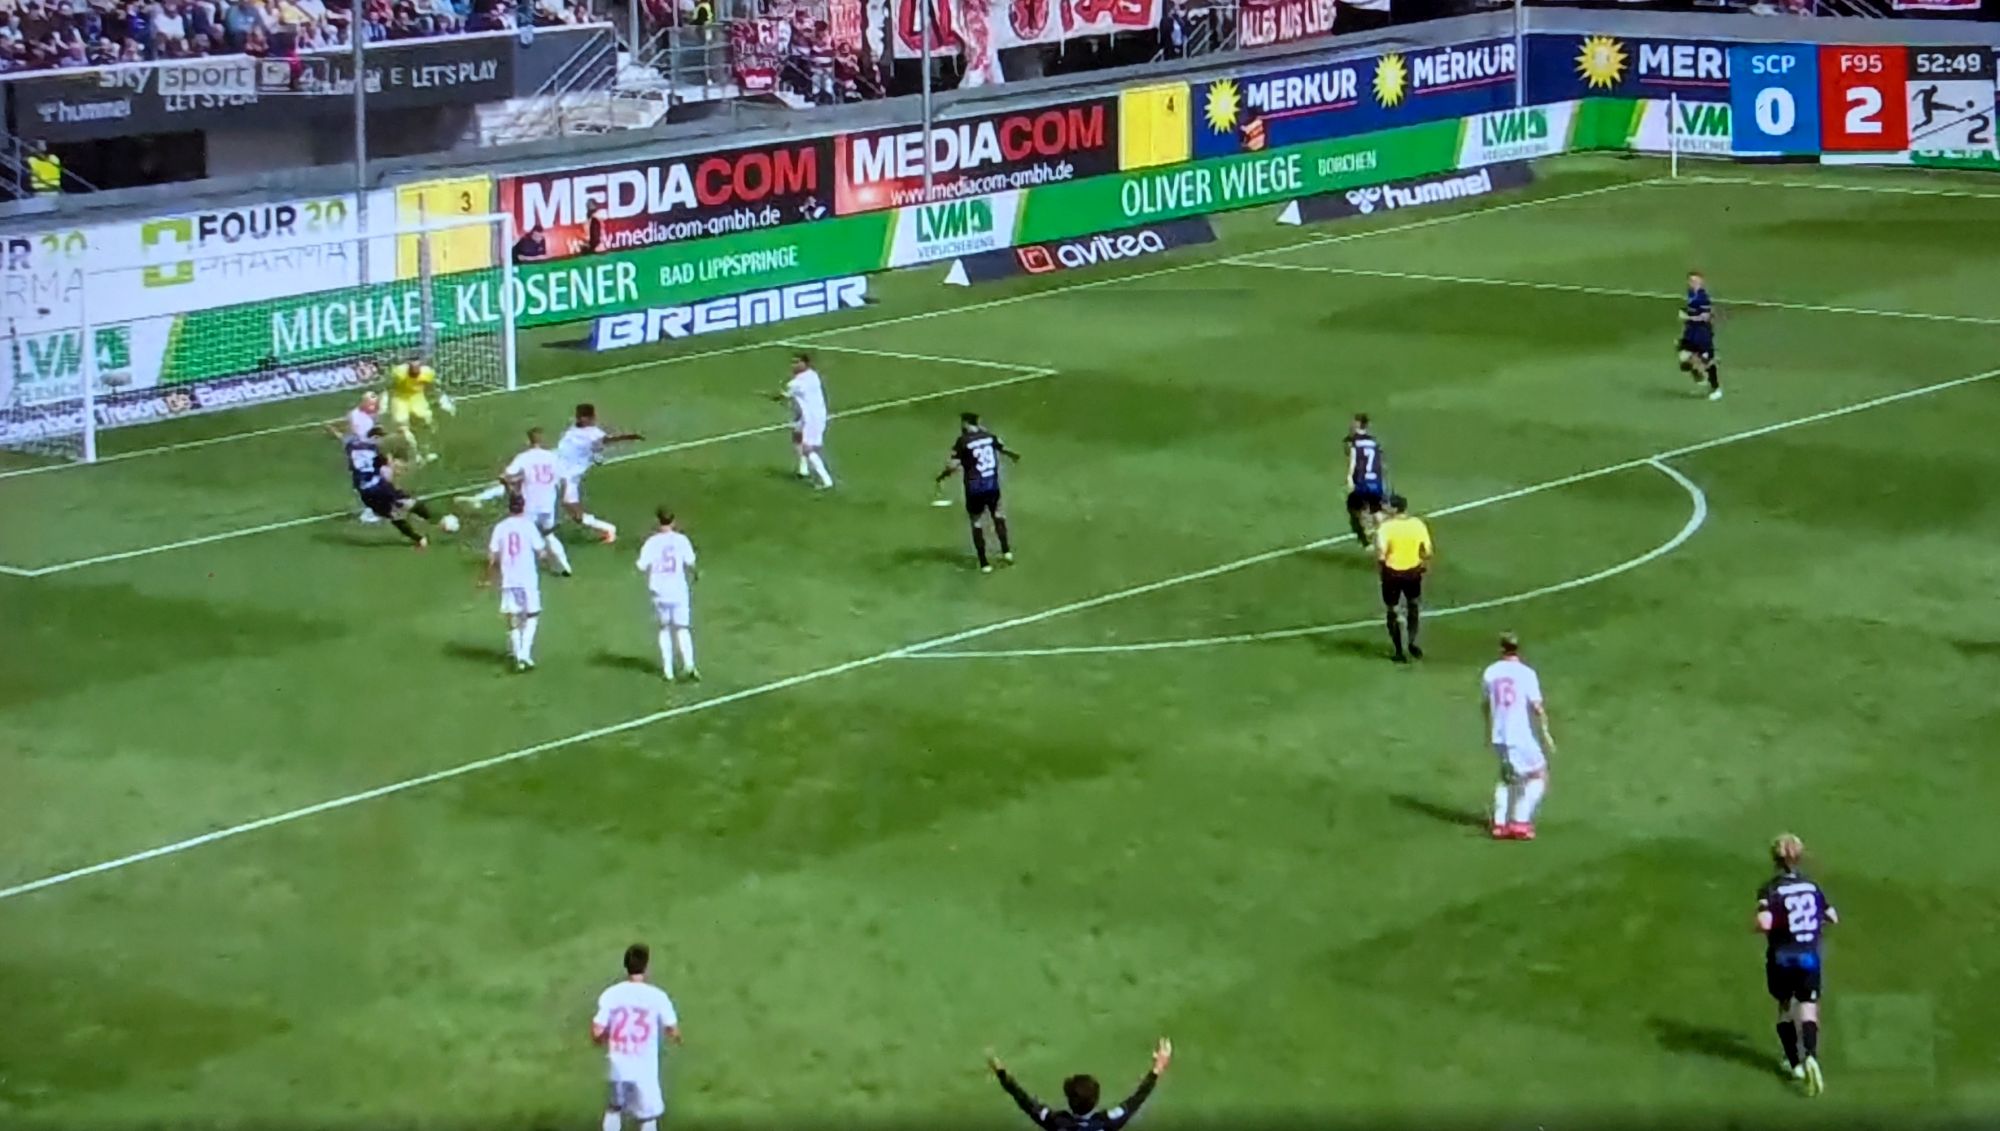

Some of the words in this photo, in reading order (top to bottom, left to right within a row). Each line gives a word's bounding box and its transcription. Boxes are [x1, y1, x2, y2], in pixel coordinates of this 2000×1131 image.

[459, 59, 498, 82] PLAY
[1413, 44, 1516, 88] MERKUR
[1638, 44, 1730, 78] MER
[1247, 67, 1358, 112] MERKUR
[852, 105, 1104, 185] MEDIACOM
[1481, 109, 1526, 147] LVM
[461, 191, 472, 212] 3
[521, 146, 818, 231] MEDIACOM
[1121, 168, 1211, 218] OLIVER
[1219, 153, 1303, 201] WIEGE
[1317, 149, 1377, 177] BORCHEN
[1382, 168, 1492, 210] hummel
[198, 205, 298, 244] FOUR
[916, 200, 969, 243] LVM
[1057, 230, 1166, 269] avitea
[272, 291, 446, 358] MICHAEL
[454, 260, 639, 326] KLÖSENER
[659, 263, 695, 287] BAD
[699, 244, 799, 281] LIPPSPRINGE
[596, 274, 868, 352] BREMER
[972, 445, 995, 472] 39
[1363, 447, 1375, 473] 7
[1784, 892, 1819, 933] 22
[610, 1005, 651, 1043] 23
